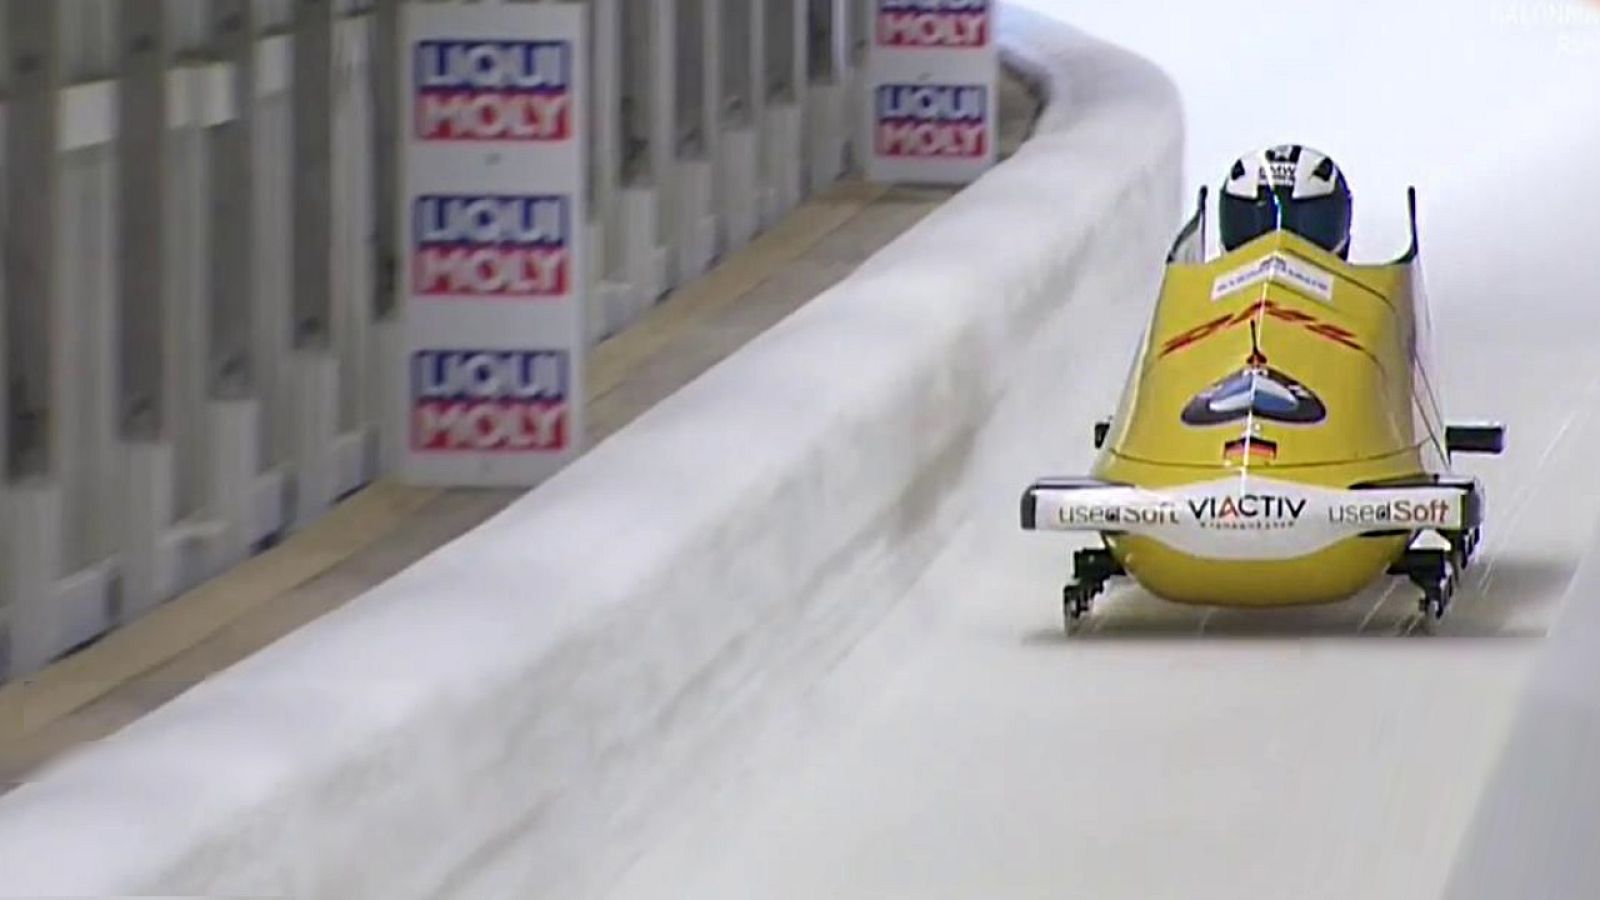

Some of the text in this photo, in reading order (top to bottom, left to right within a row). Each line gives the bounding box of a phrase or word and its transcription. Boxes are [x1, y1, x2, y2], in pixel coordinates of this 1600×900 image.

[879, 13, 986, 45] MOLY
[419, 44, 566, 88] LIQUI
[417, 95, 569, 139] MOLY
[878, 87, 984, 119] LIQUI
[878, 123, 986, 156] MOLY
[418, 198, 566, 242] LIQUI
[416, 248, 567, 293] MOLY
[416, 353, 564, 397] LIQUI
[415, 403, 567, 448] MOLY
[1187, 494, 1307, 519] VIACTIV
[1327, 499, 1450, 524] usedSoft
